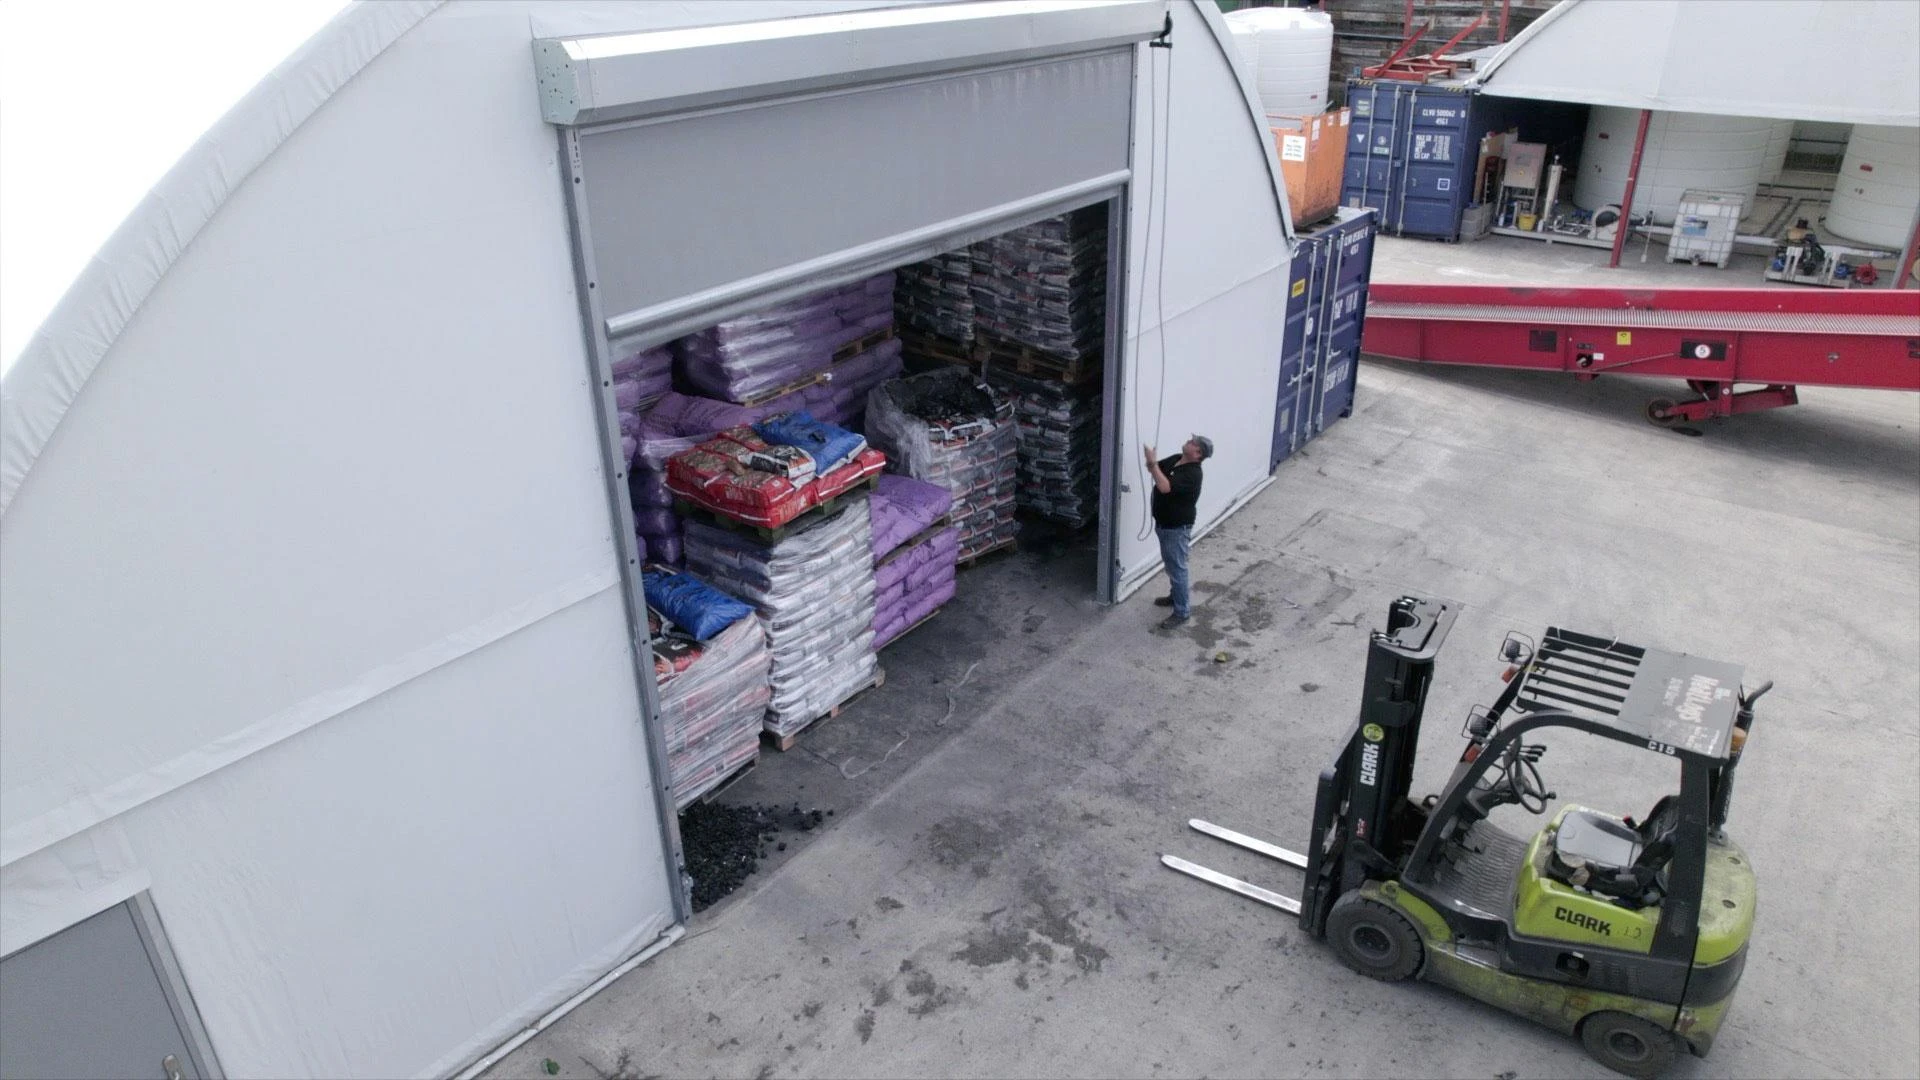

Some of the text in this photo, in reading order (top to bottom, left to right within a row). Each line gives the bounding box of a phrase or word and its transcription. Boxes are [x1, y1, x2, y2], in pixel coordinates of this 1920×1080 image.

[1699, 346, 1706, 355] 5
[1647, 739, 1676, 756] C15
[1360, 742, 1379, 787] CLARK
[1554, 905, 1612, 936] CLARK
